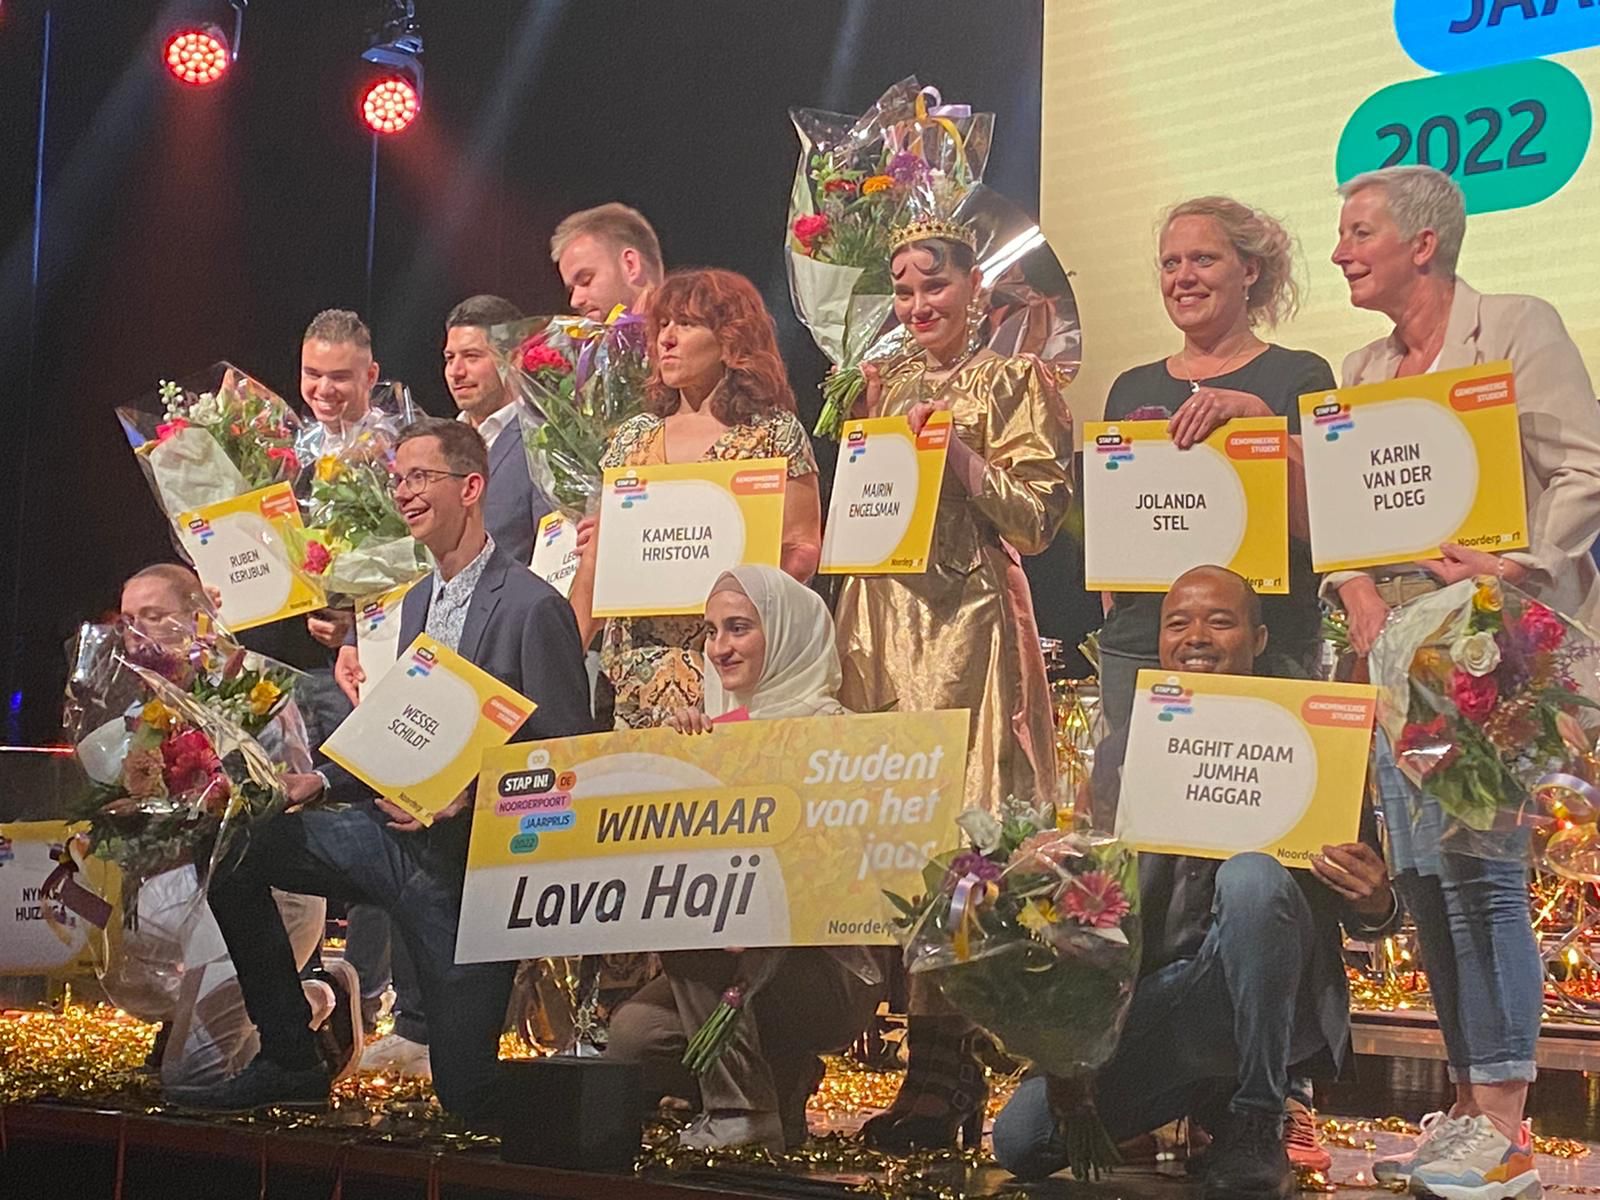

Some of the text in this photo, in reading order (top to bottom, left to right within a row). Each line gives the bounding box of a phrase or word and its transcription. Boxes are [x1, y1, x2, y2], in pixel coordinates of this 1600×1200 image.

[1376, 99, 1547, 177] 2022
[1370, 443, 1420, 466] KARIN
[1362, 465, 1432, 489] VAN DER
[861, 482, 894, 499] MAIRIN
[1374, 489, 1425, 511] PLOEG
[849, 502, 900, 518] ENGELSMAN
[1135, 494, 1206, 510] JOLANDA
[1153, 515, 1189, 531] STEL
[642, 526, 713, 543] KAMELIJA
[230, 549, 260, 568] RUBEN
[642, 546, 710, 562] HRISTOVA
[402, 704, 440, 736] WESSEL
[388, 719, 430, 750] SCHILDT
[1167, 738, 1293, 763] BAGHIT ADAM
[803, 744, 944, 785] Student
[1193, 763, 1259, 784] JUMHA
[504, 774, 574, 792] STAP IN! DE
[499, 795, 568, 812] NOORDERPOORT
[1185, 784, 1262, 807] HAGGAR
[805, 788, 941, 828] van het
[597, 797, 776, 843] WINNAAR
[507, 854, 760, 933] Lava Haji
